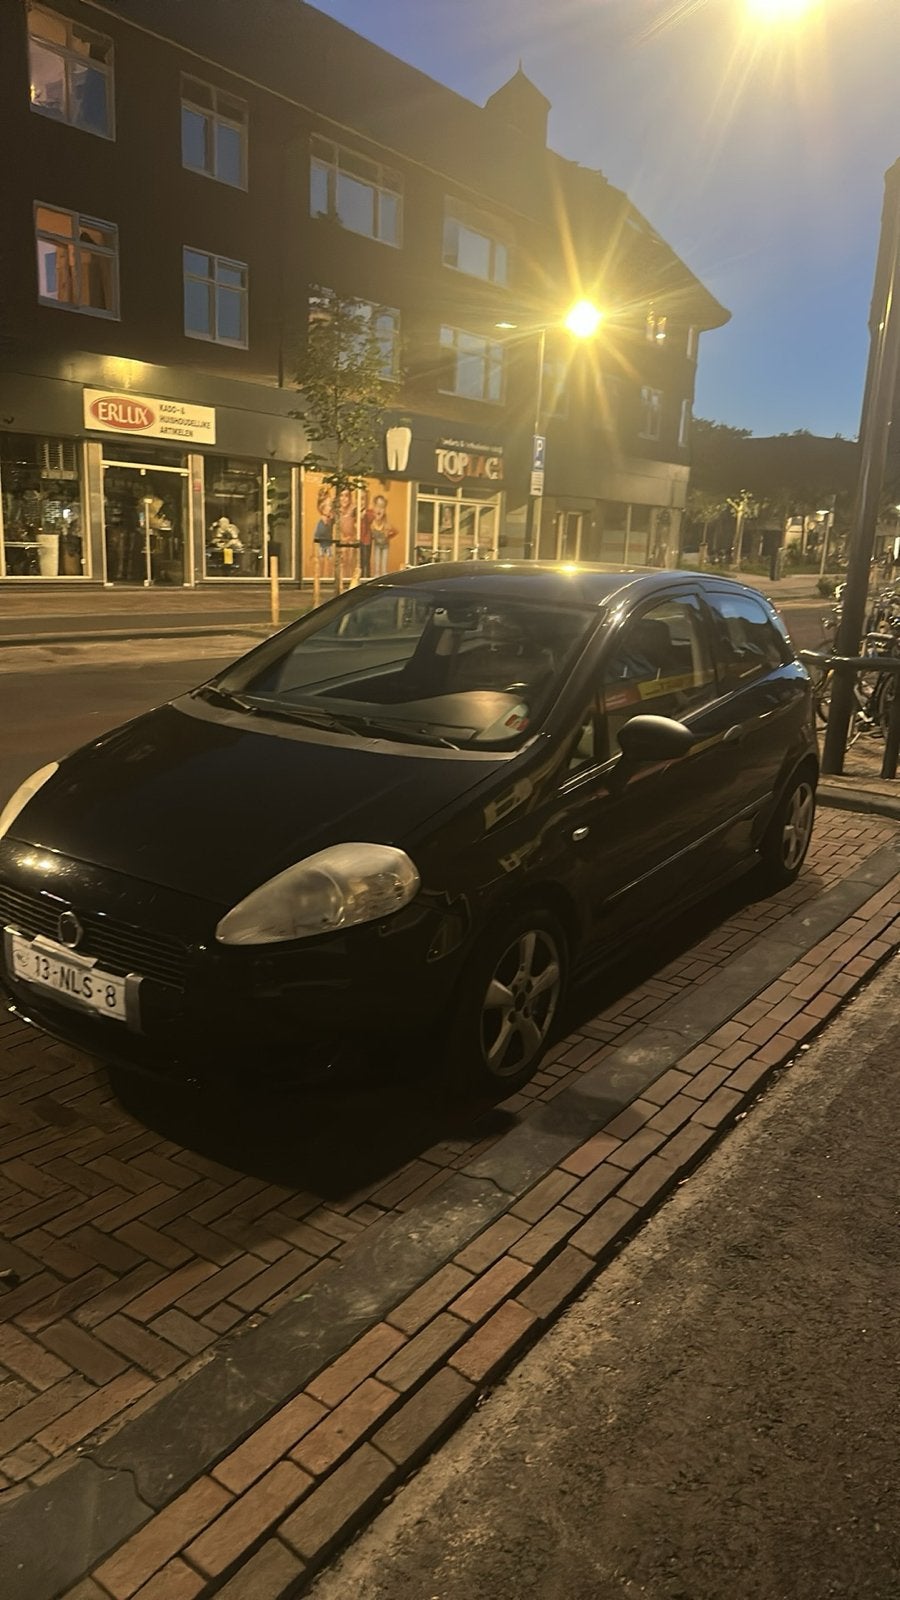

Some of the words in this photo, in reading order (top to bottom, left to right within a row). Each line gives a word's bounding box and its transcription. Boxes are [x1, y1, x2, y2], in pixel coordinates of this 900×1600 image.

[98, 402, 148, 426] ERLUX
[160, 426, 194, 437] ARTIKELEN
[35, 955, 116, 1008] 13-NLS-8
